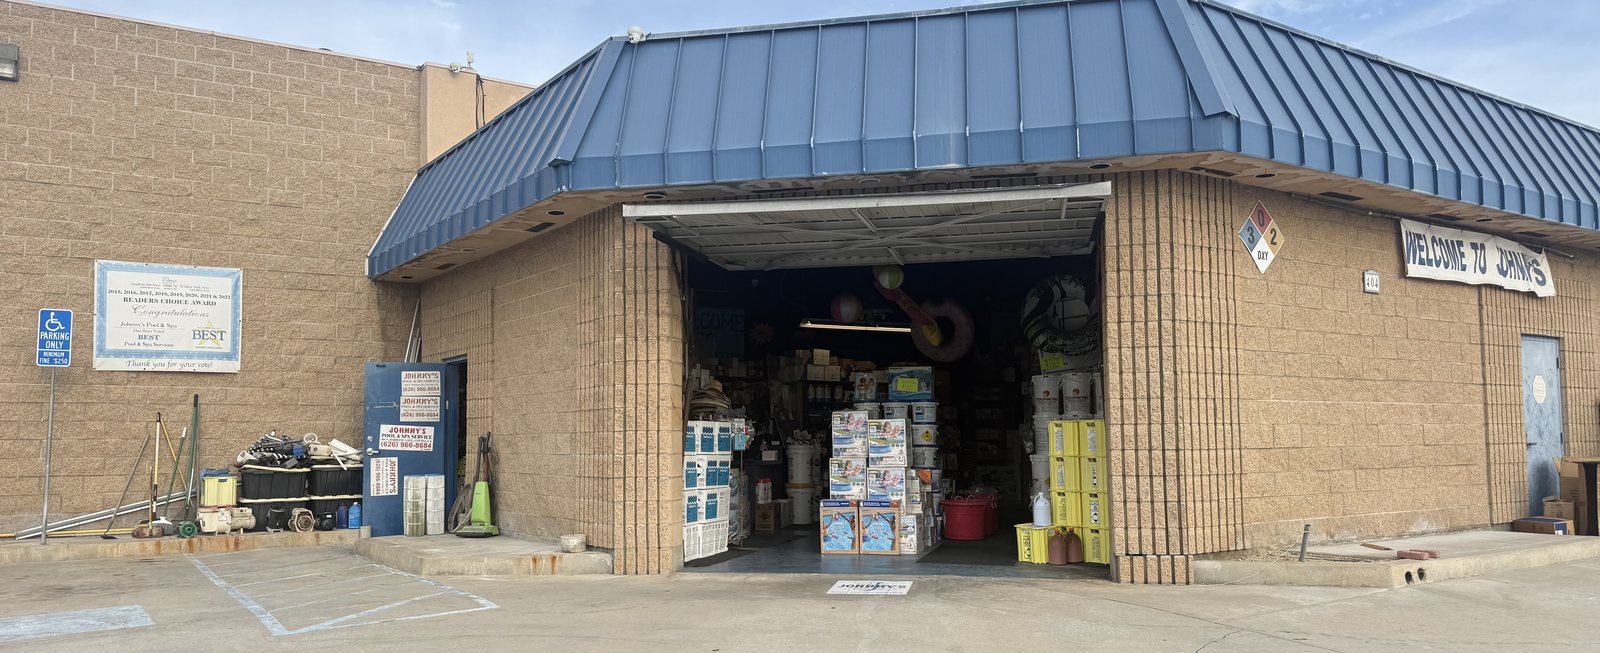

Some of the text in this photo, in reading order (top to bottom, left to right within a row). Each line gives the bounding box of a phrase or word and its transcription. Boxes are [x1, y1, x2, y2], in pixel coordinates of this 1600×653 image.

[1258, 210, 1264, 227] 0
[1247, 226, 1277, 245] 3 2
[1258, 250, 1268, 260] OXY
[1406, 230, 1466, 272] WELCOME
[1470, 242, 1487, 274] TO
[1366, 277, 1379, 288] 404
[132, 305, 209, 318] Congratulations
[40, 332, 69, 340] PARKING
[192, 330, 227, 341] BEST
